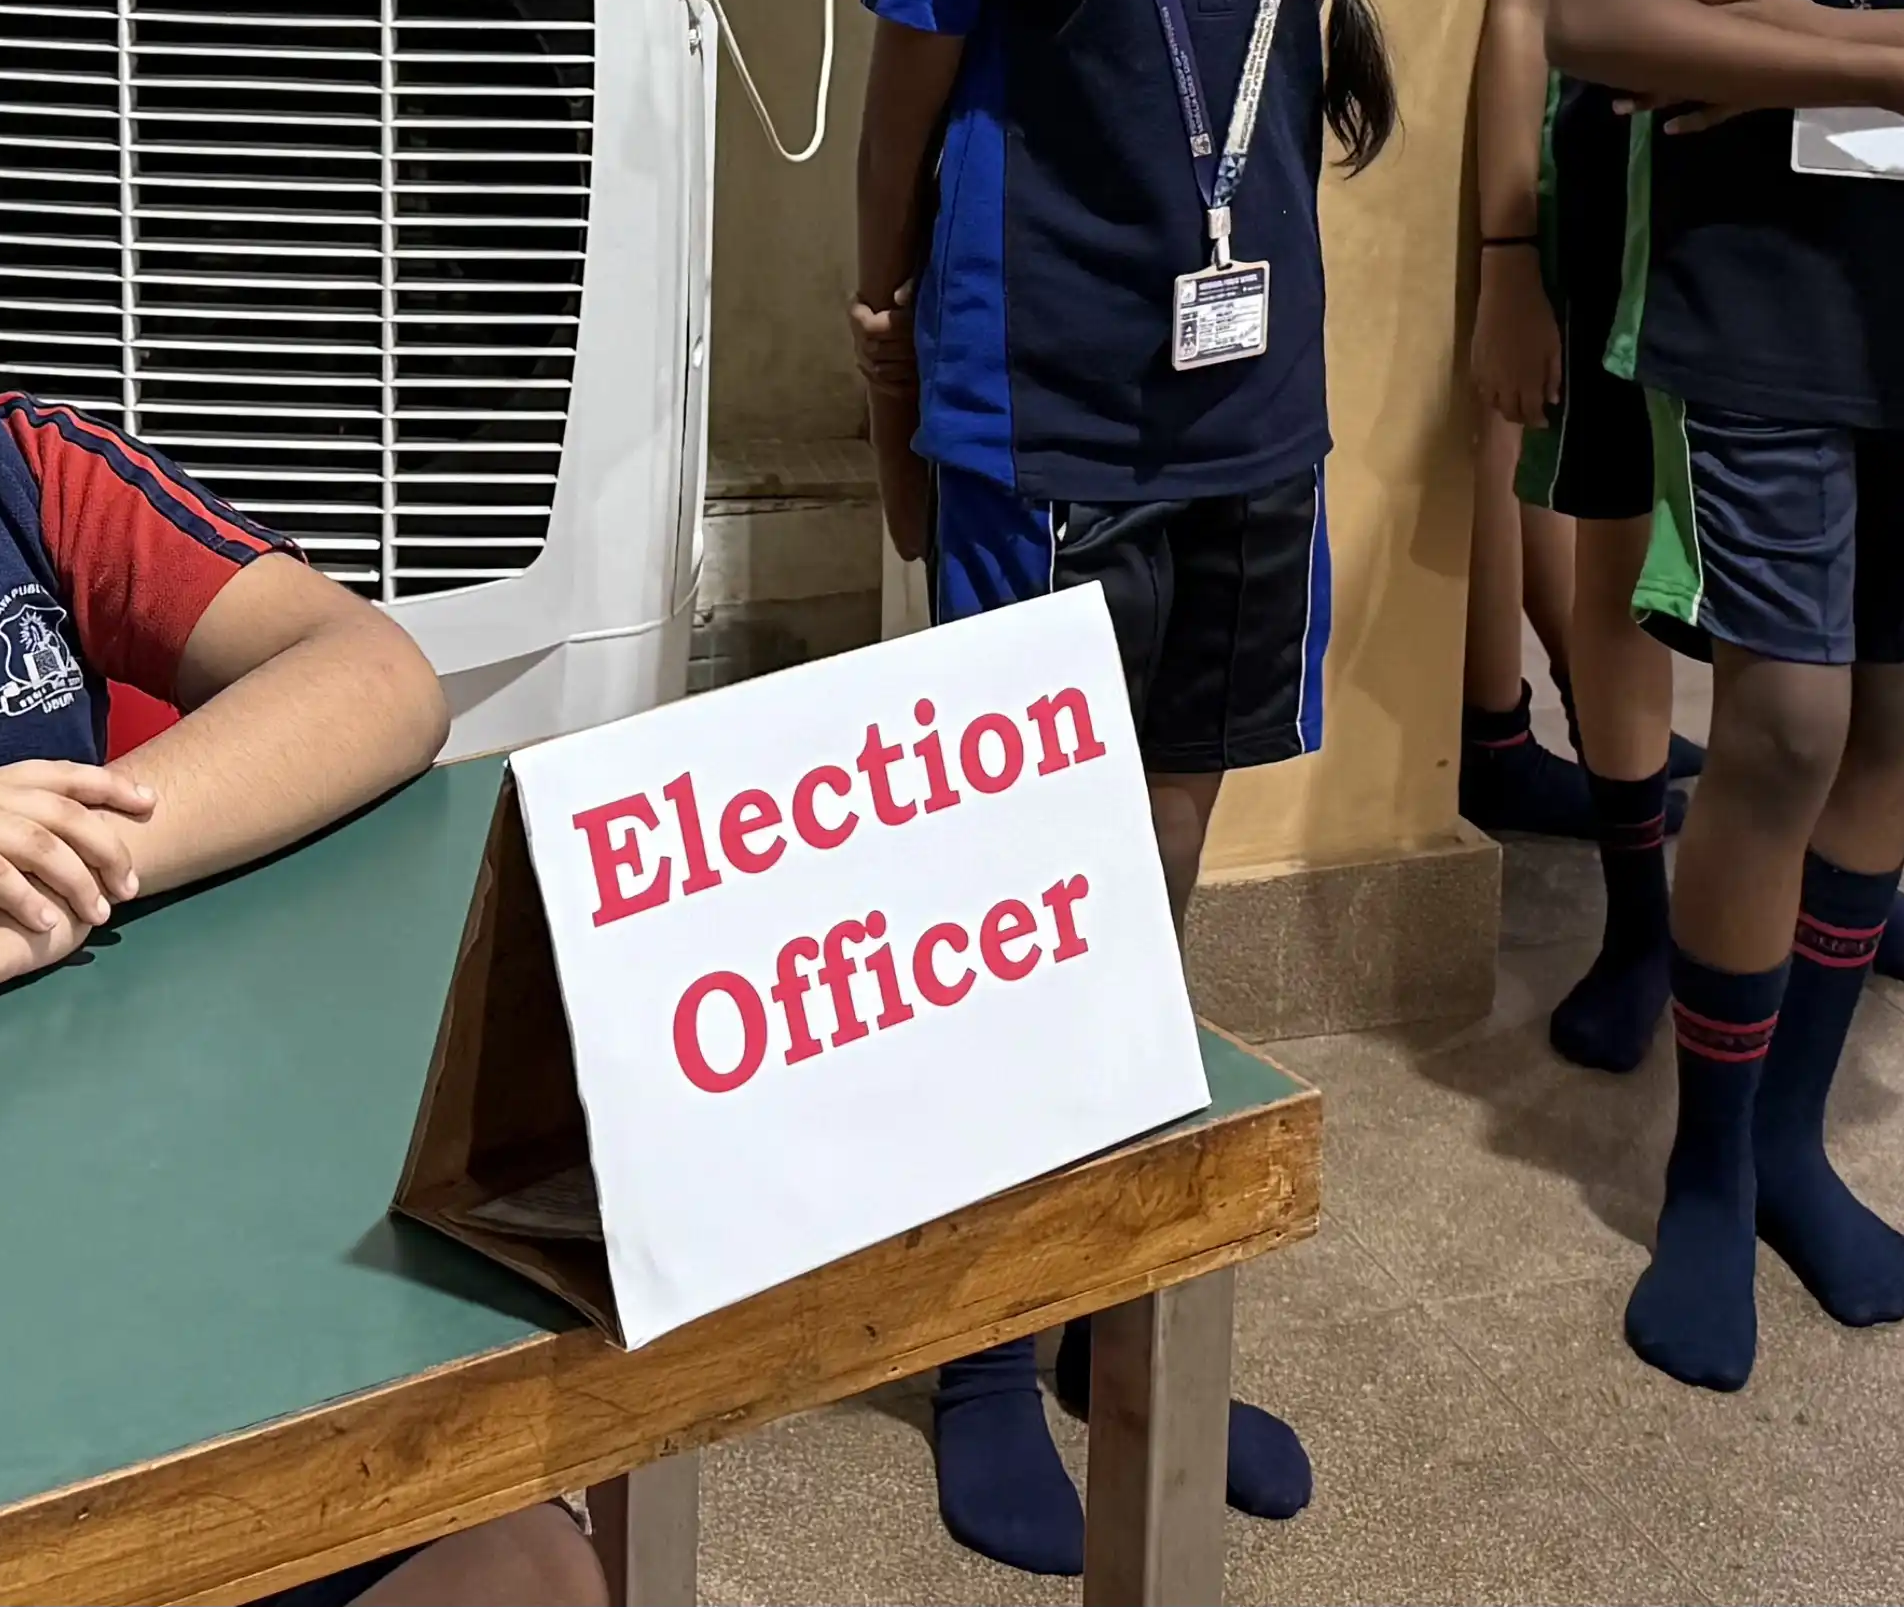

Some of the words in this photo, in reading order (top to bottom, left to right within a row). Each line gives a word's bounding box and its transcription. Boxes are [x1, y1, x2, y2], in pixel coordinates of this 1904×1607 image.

[10, 583, 41, 598] PUBL
[572, 687, 1107, 928] Election
[672, 874, 1090, 1094] Officer
